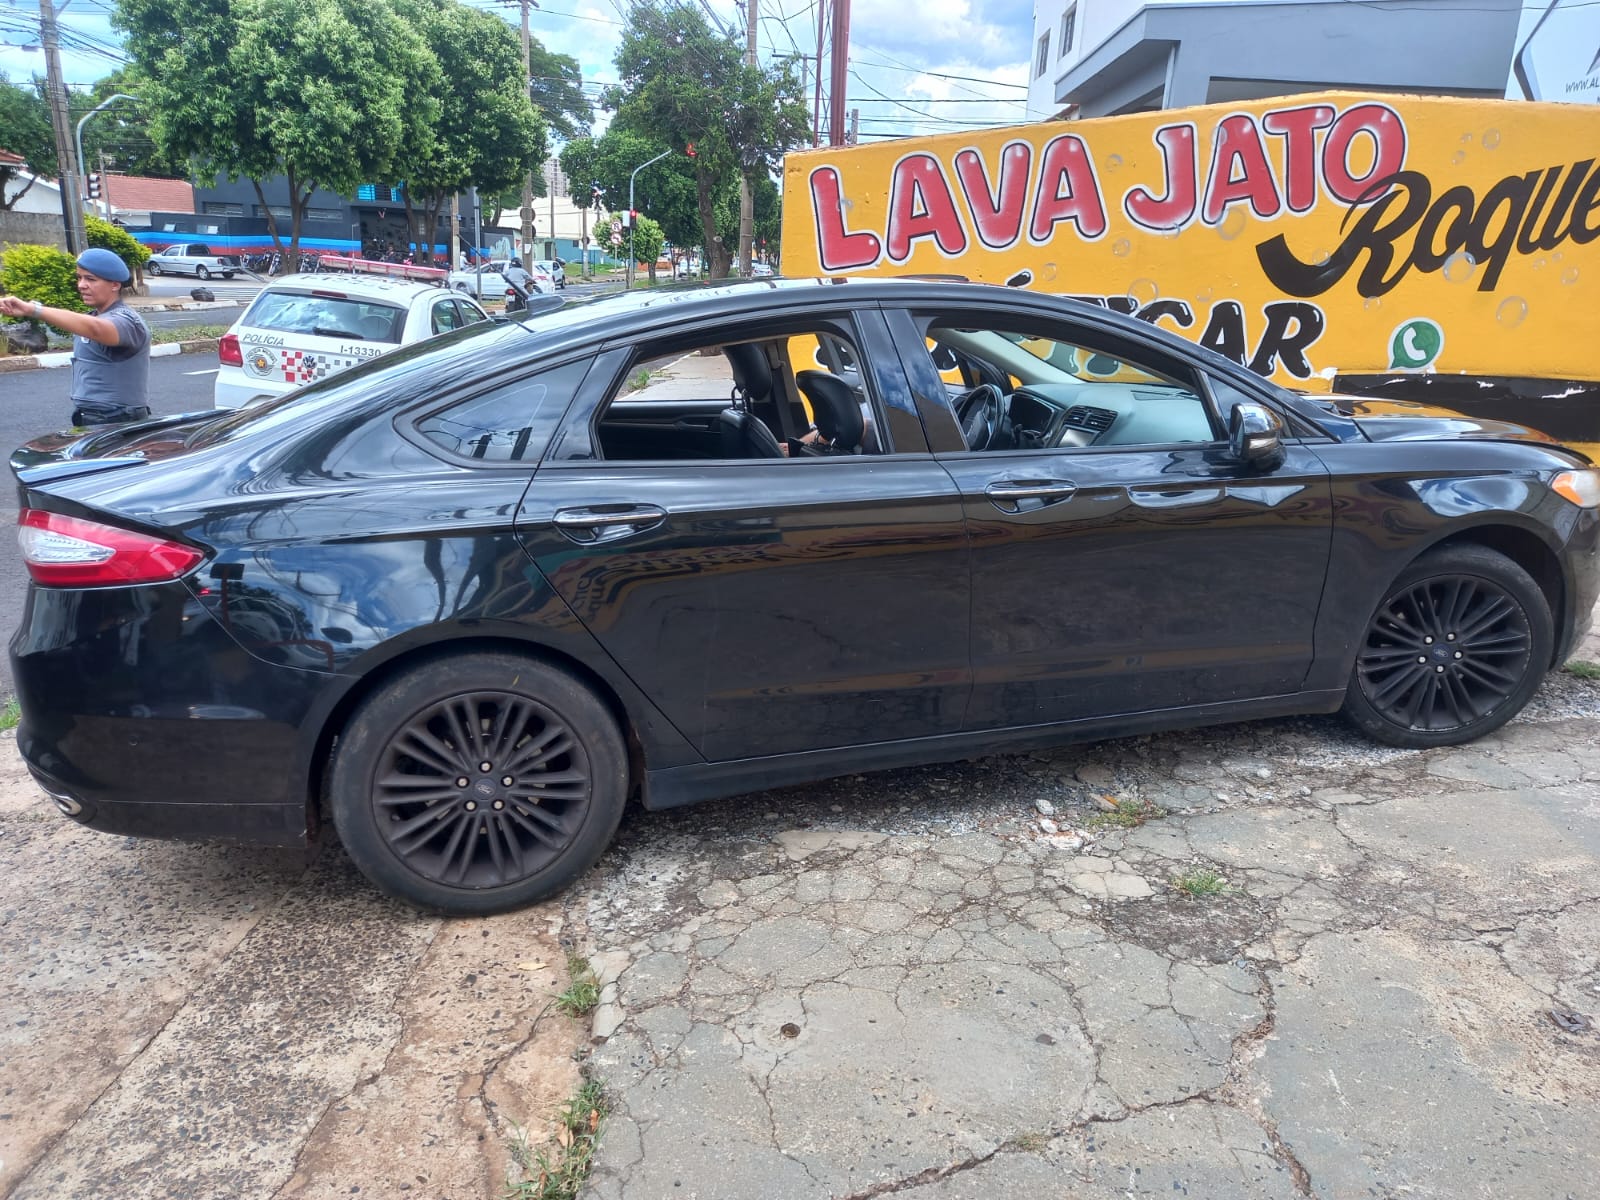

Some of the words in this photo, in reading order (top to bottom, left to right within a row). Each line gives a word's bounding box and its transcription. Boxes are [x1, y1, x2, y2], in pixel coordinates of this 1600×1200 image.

[809, 134, 1107, 272] LAVA
[1124, 103, 1406, 231] JATO
[1256, 158, 1600, 298] Roque
[243, 333, 285, 346] POLÍCIA
[340, 344, 382, 358] I-13330
